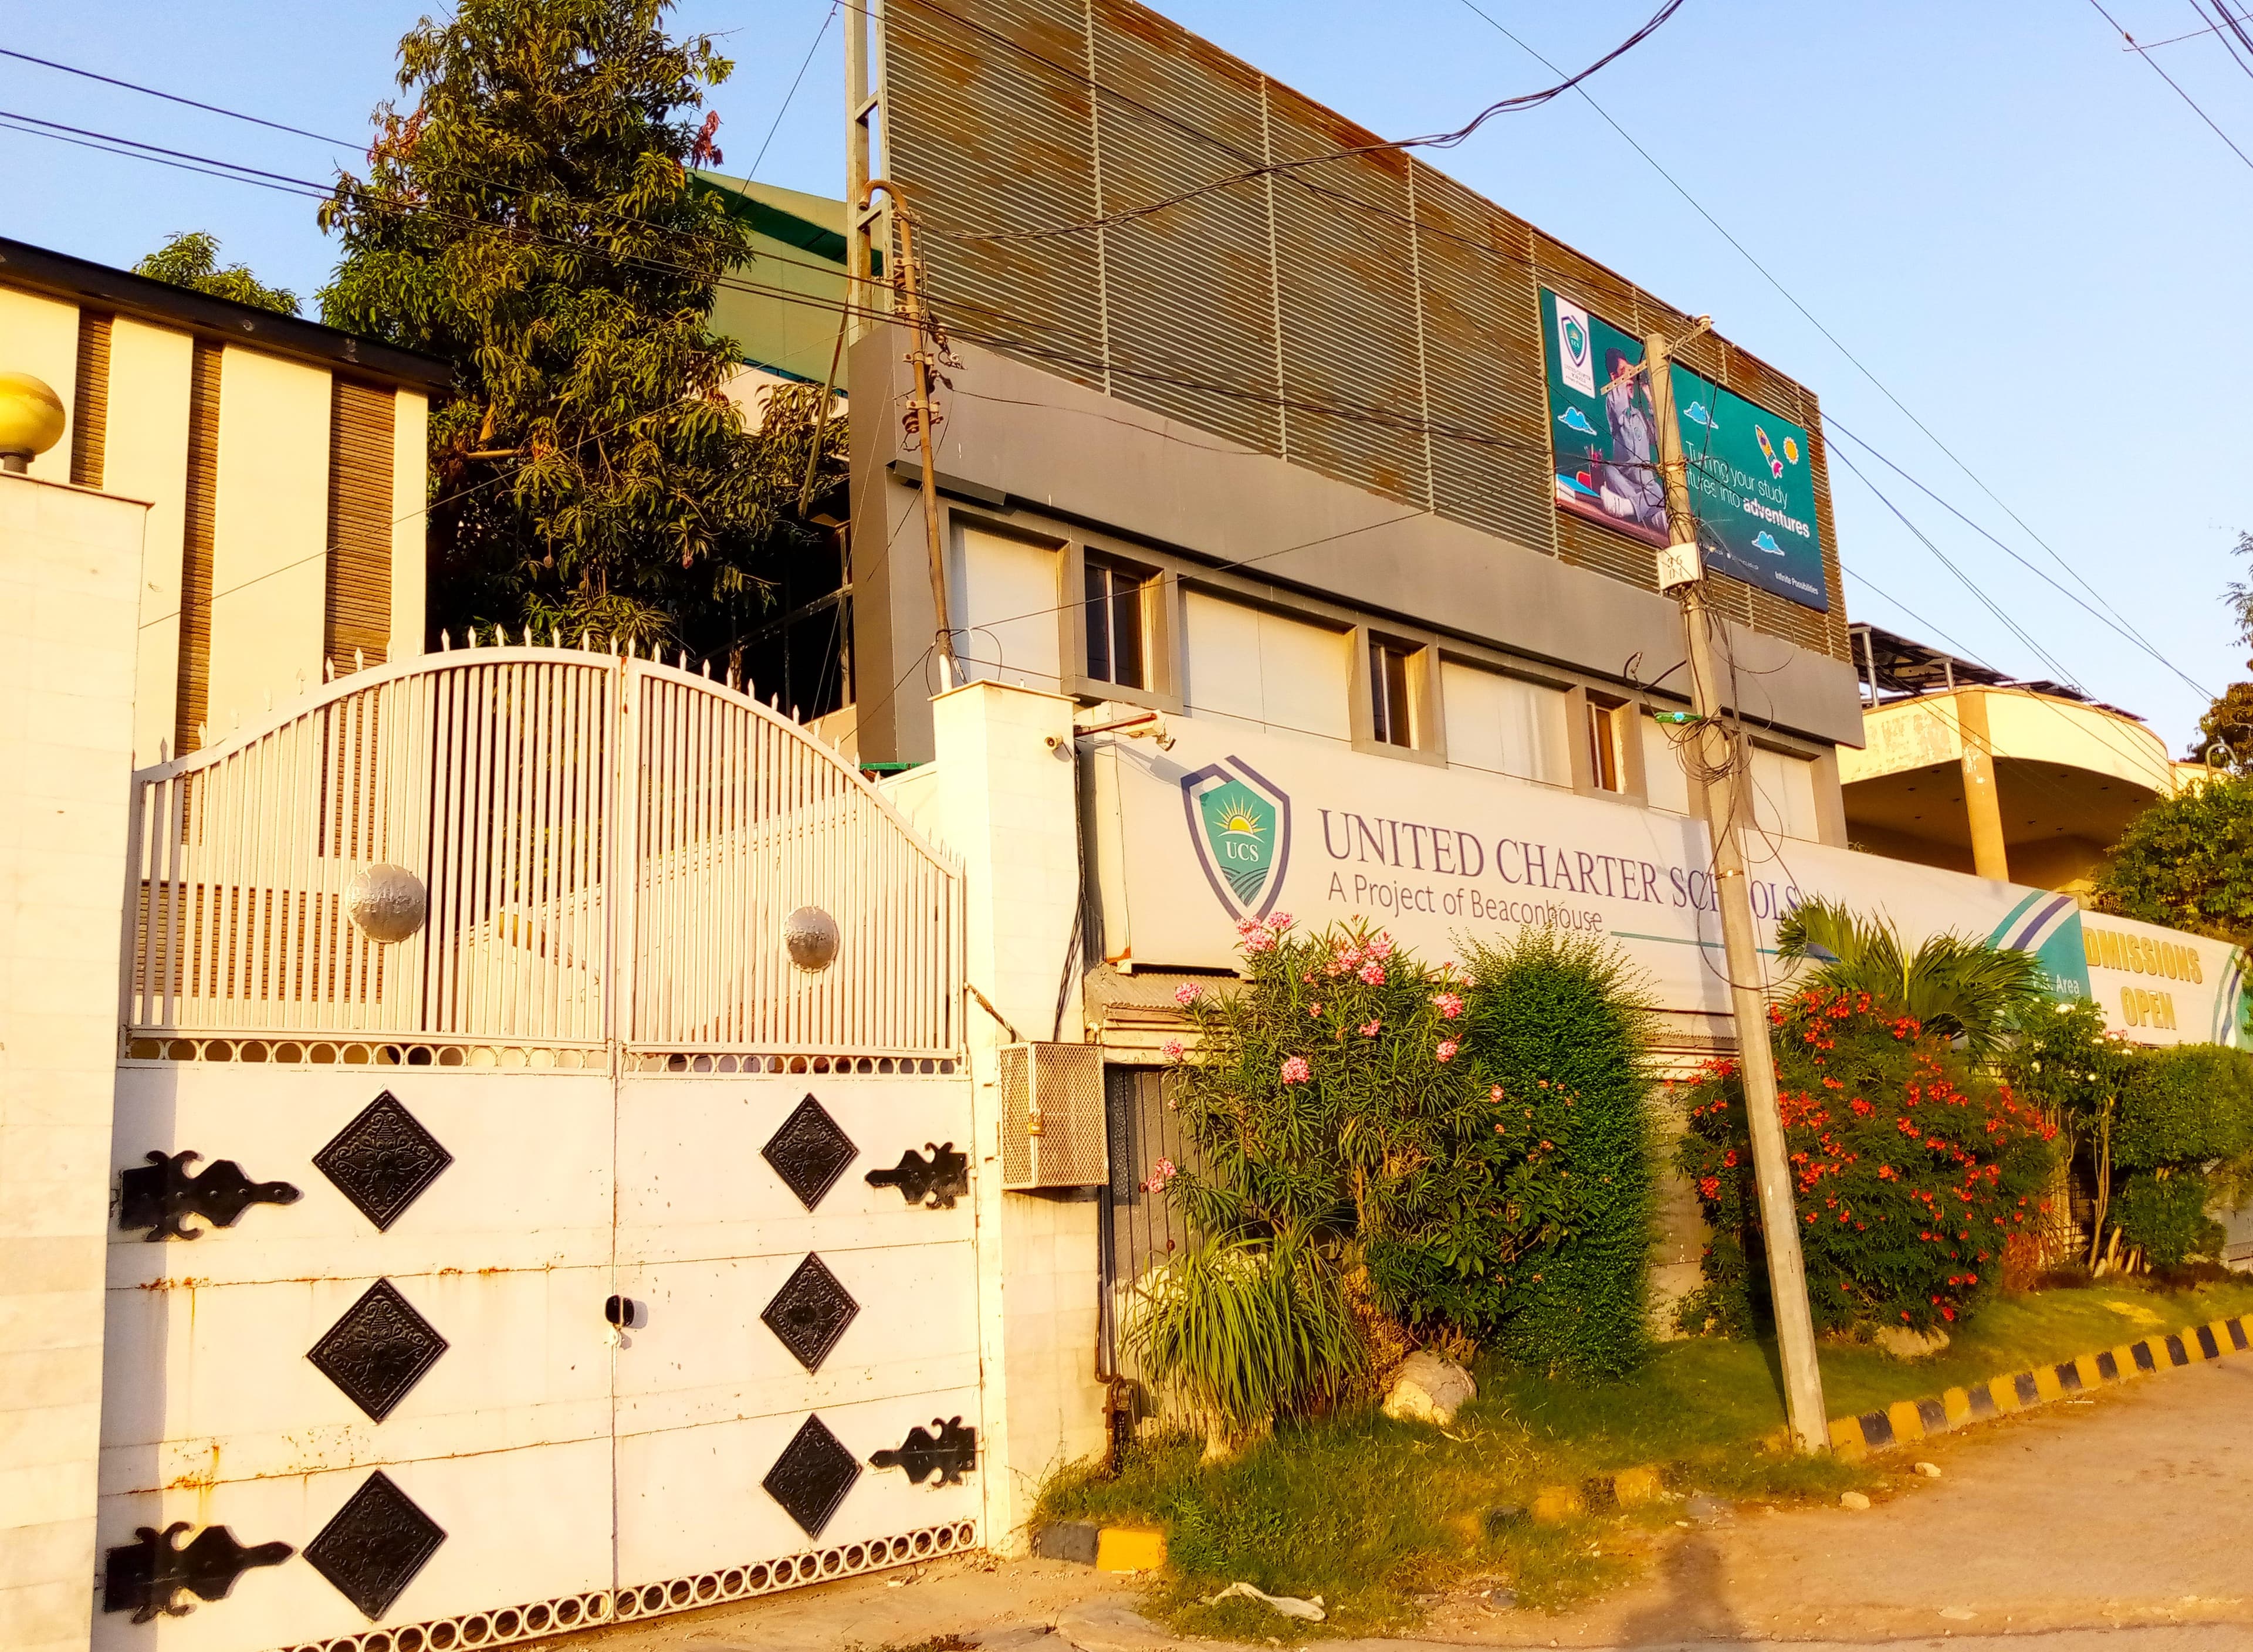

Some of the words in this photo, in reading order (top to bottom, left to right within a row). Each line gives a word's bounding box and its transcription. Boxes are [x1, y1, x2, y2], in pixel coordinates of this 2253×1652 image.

[1686, 440, 1728, 483] Turning
[1730, 468, 1755, 492] your
[1758, 480, 1788, 510] study
[1720, 484, 1741, 508] into
[1743, 497, 1811, 539] adventures
[1225, 840, 1260, 862] UCS
[1317, 808, 1484, 878] UNITED
[1497, 838, 1663, 904] CHARTER
[1670, 866, 1799, 921] SCHOLS
[1328, 871, 1347, 903] A
[1356, 874, 1434, 918] Project
[1443, 887, 1465, 916] of
[1471, 889, 1603, 933] Beaconhouse
[2082, 926, 2203, 984] DMISSIONS
[2056, 973, 2081, 996] Area
[2120, 986, 2177, 1031] OPEN
